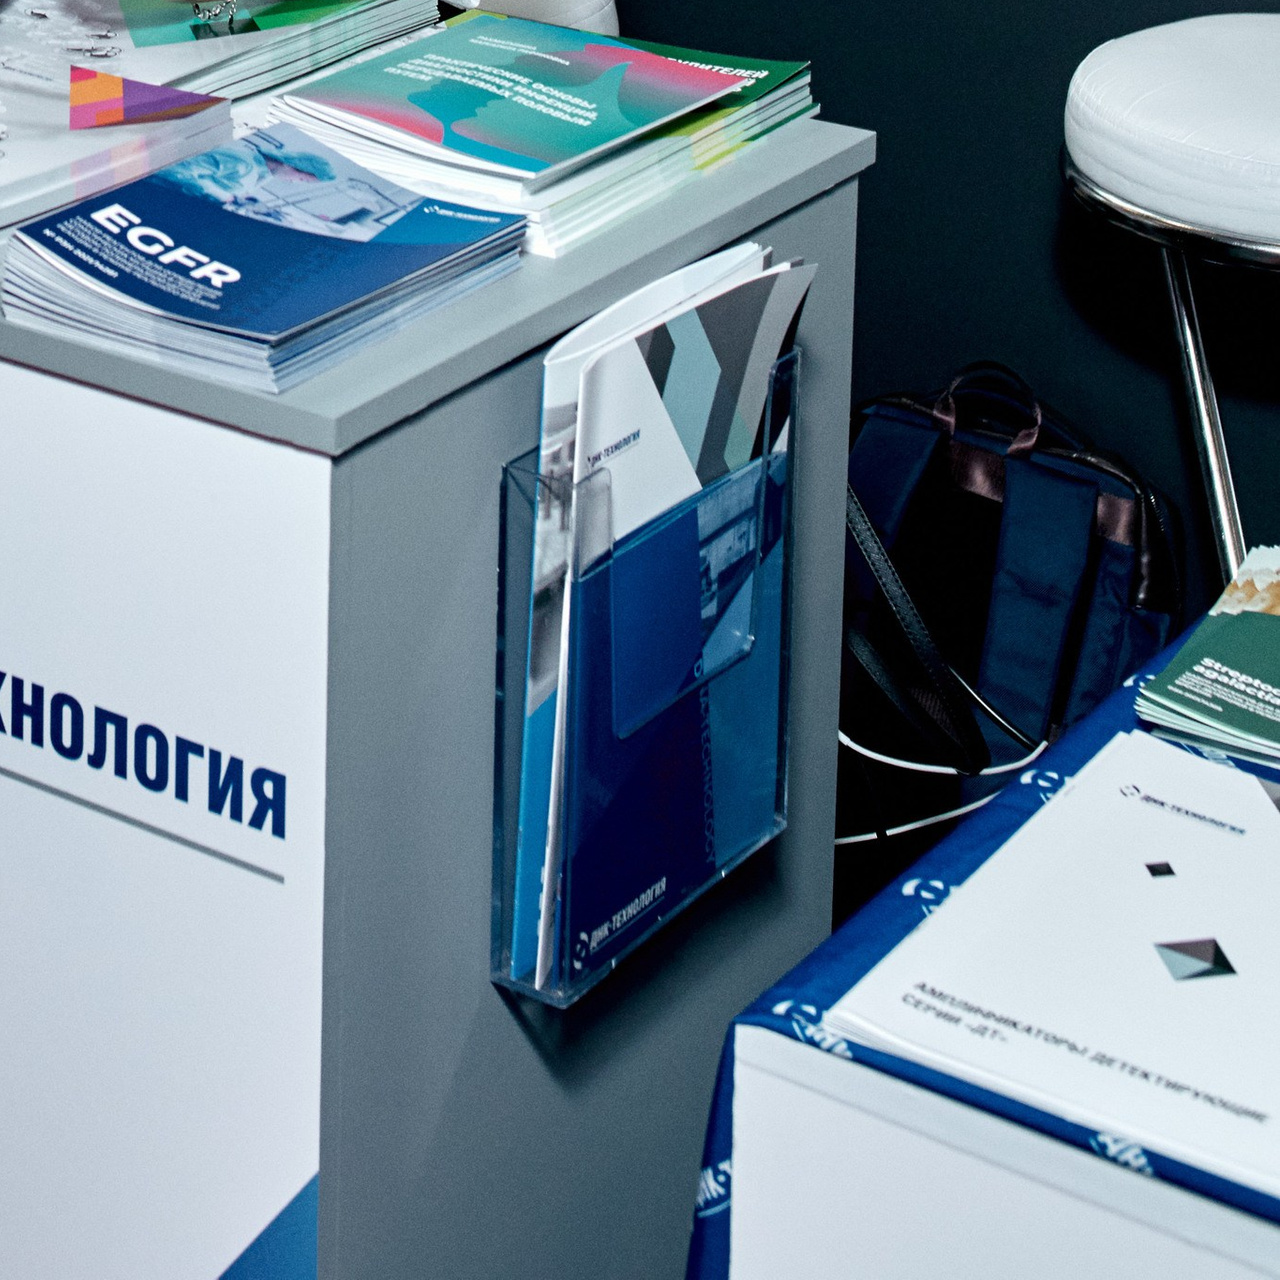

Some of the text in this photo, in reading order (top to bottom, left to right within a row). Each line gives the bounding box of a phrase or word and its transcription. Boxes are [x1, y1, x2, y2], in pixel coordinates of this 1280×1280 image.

[512, 95, 592, 127] ПОЛОВЫМ
[532, 82, 597, 109] ОСНОВЫ
[90, 202, 242, 289] EGFR
[589, 874, 667, 951] ДНК-ТЕХНОЛОГИЯ
[900, 992, 961, 1027] СЕРИИ
[913, 981, 1087, 1057] АМПЛИФИКАТОРЫ
[1088, 1050, 1269, 1124] ДЕТЕКТИРУЮЩИЕ
